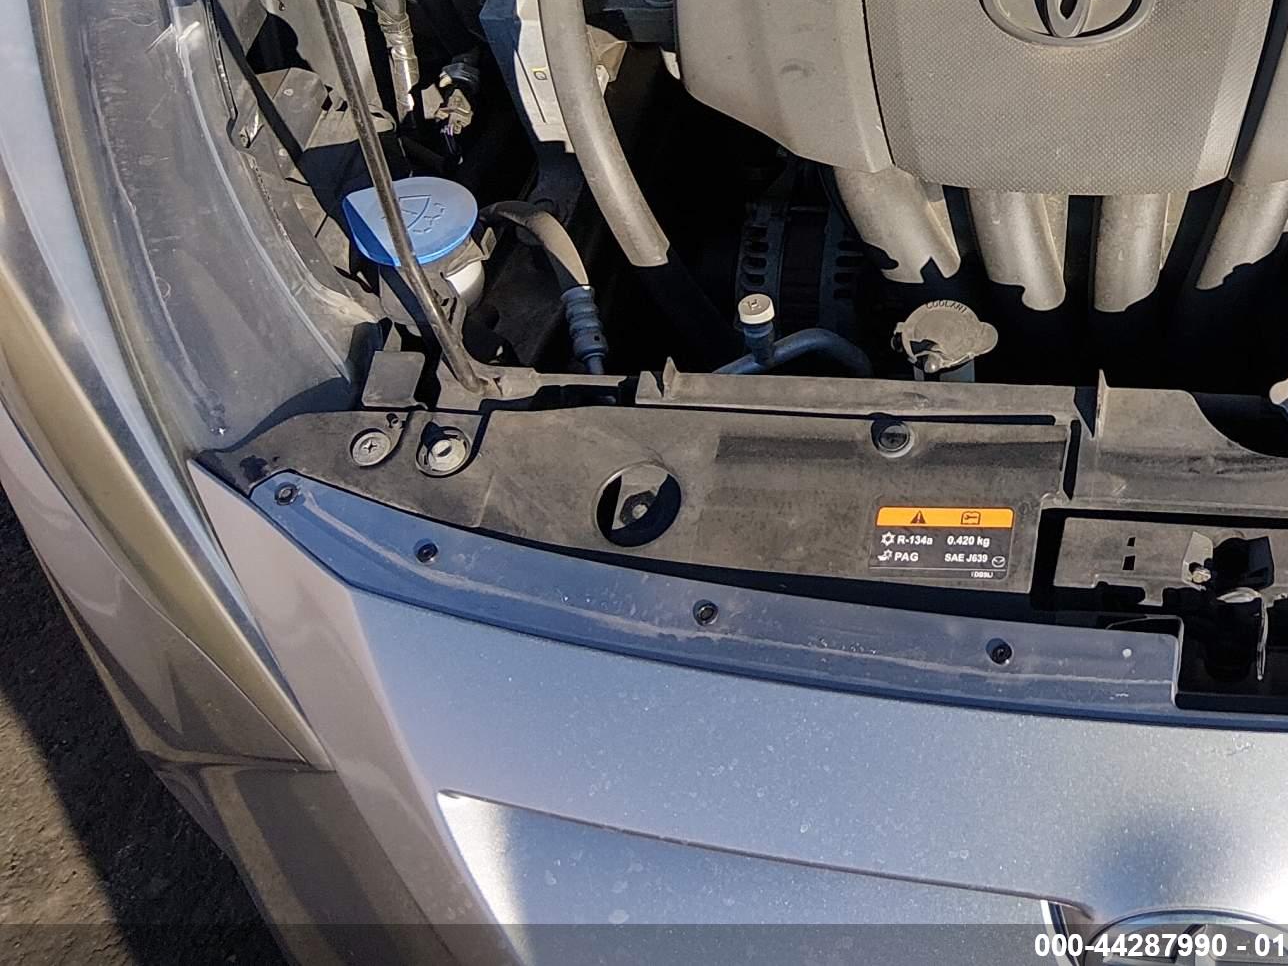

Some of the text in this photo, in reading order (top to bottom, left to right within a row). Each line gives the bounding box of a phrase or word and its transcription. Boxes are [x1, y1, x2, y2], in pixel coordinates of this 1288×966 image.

[897, 535, 990, 547] R-134a 0.420 kg
[894, 552, 988, 563] PAG SAE J639
